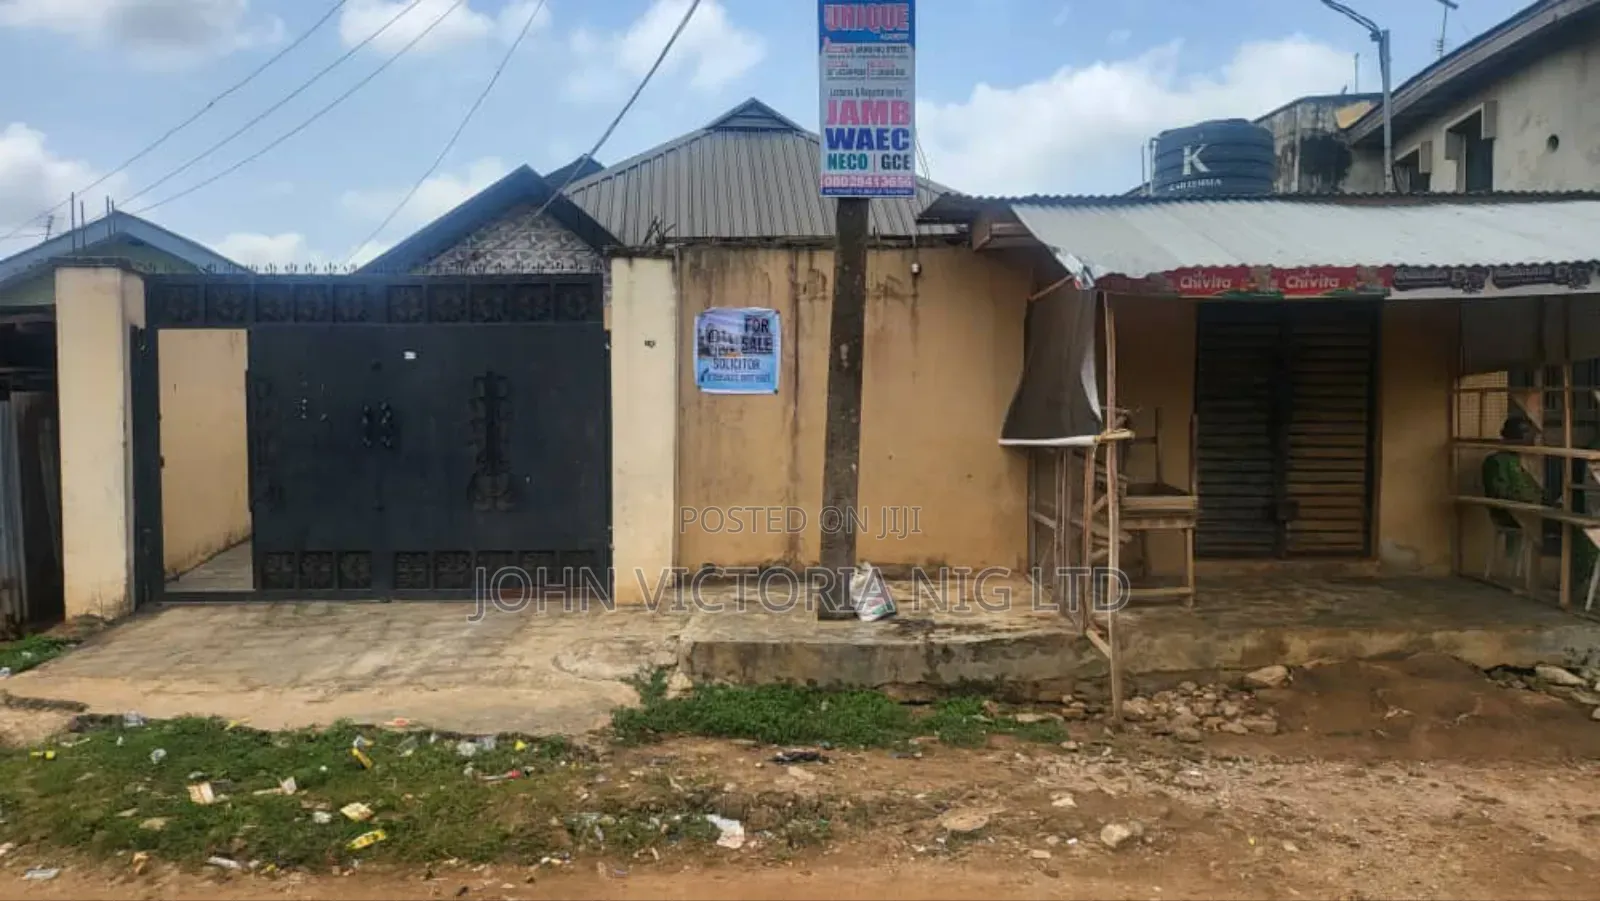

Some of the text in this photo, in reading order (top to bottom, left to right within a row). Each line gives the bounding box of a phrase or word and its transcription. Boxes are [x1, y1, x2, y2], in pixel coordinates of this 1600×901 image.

[824, 3, 909, 33] UNIQUE
[826, 100, 911, 125] JAMB
[825, 128, 909, 150] WAEC
[827, 153, 911, 170] NECO GCE
[1183, 143, 1210, 175] K
[1180, 275, 1232, 289] Chivita
[1285, 274, 1339, 289] Chivita
[743, 317, 770, 333] FOR
[741, 336, 773, 351] SALE
